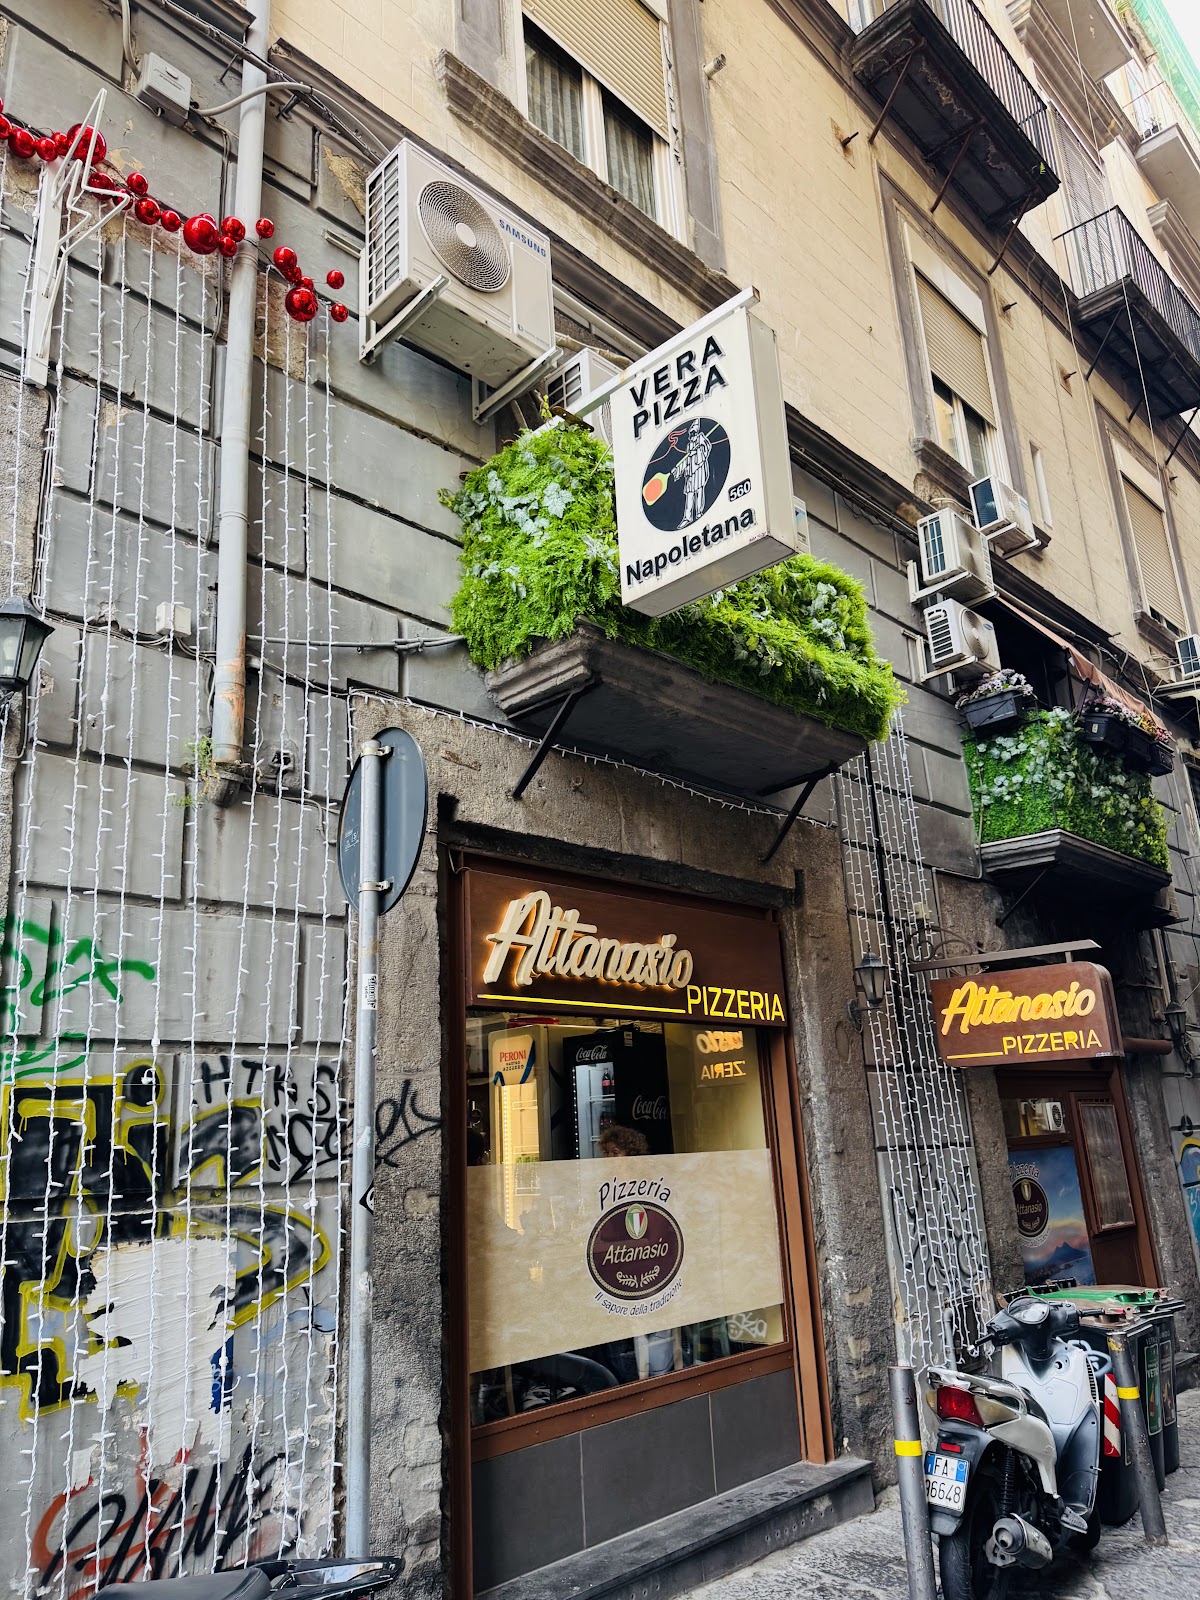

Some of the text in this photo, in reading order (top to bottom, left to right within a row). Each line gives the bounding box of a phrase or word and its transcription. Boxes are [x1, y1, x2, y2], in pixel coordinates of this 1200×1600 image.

[499, 219, 547, 257] SAMSUNG
[629, 335, 724, 407] VERA
[633, 364, 727, 439] PIZZA
[729, 480, 751, 502] 560
[626, 508, 755, 586] Napoletana
[483, 890, 694, 989] Attanasio
[686, 985, 785, 1022] PIZZERIA
[941, 980, 1096, 1036] Attanasio
[499, 1050, 527, 1063] PERONI
[1003, 1029, 1102, 1055] PIZZERIA
[598, 1176, 671, 1212] Pizzeria
[602, 1238, 669, 1266] Attanasio
[601, 1299, 629, 1316] sapore
[629, 1303, 648, 1316] della
[650, 1278, 683, 1312] tradizione
[933, 1457, 949, 1477] FA
